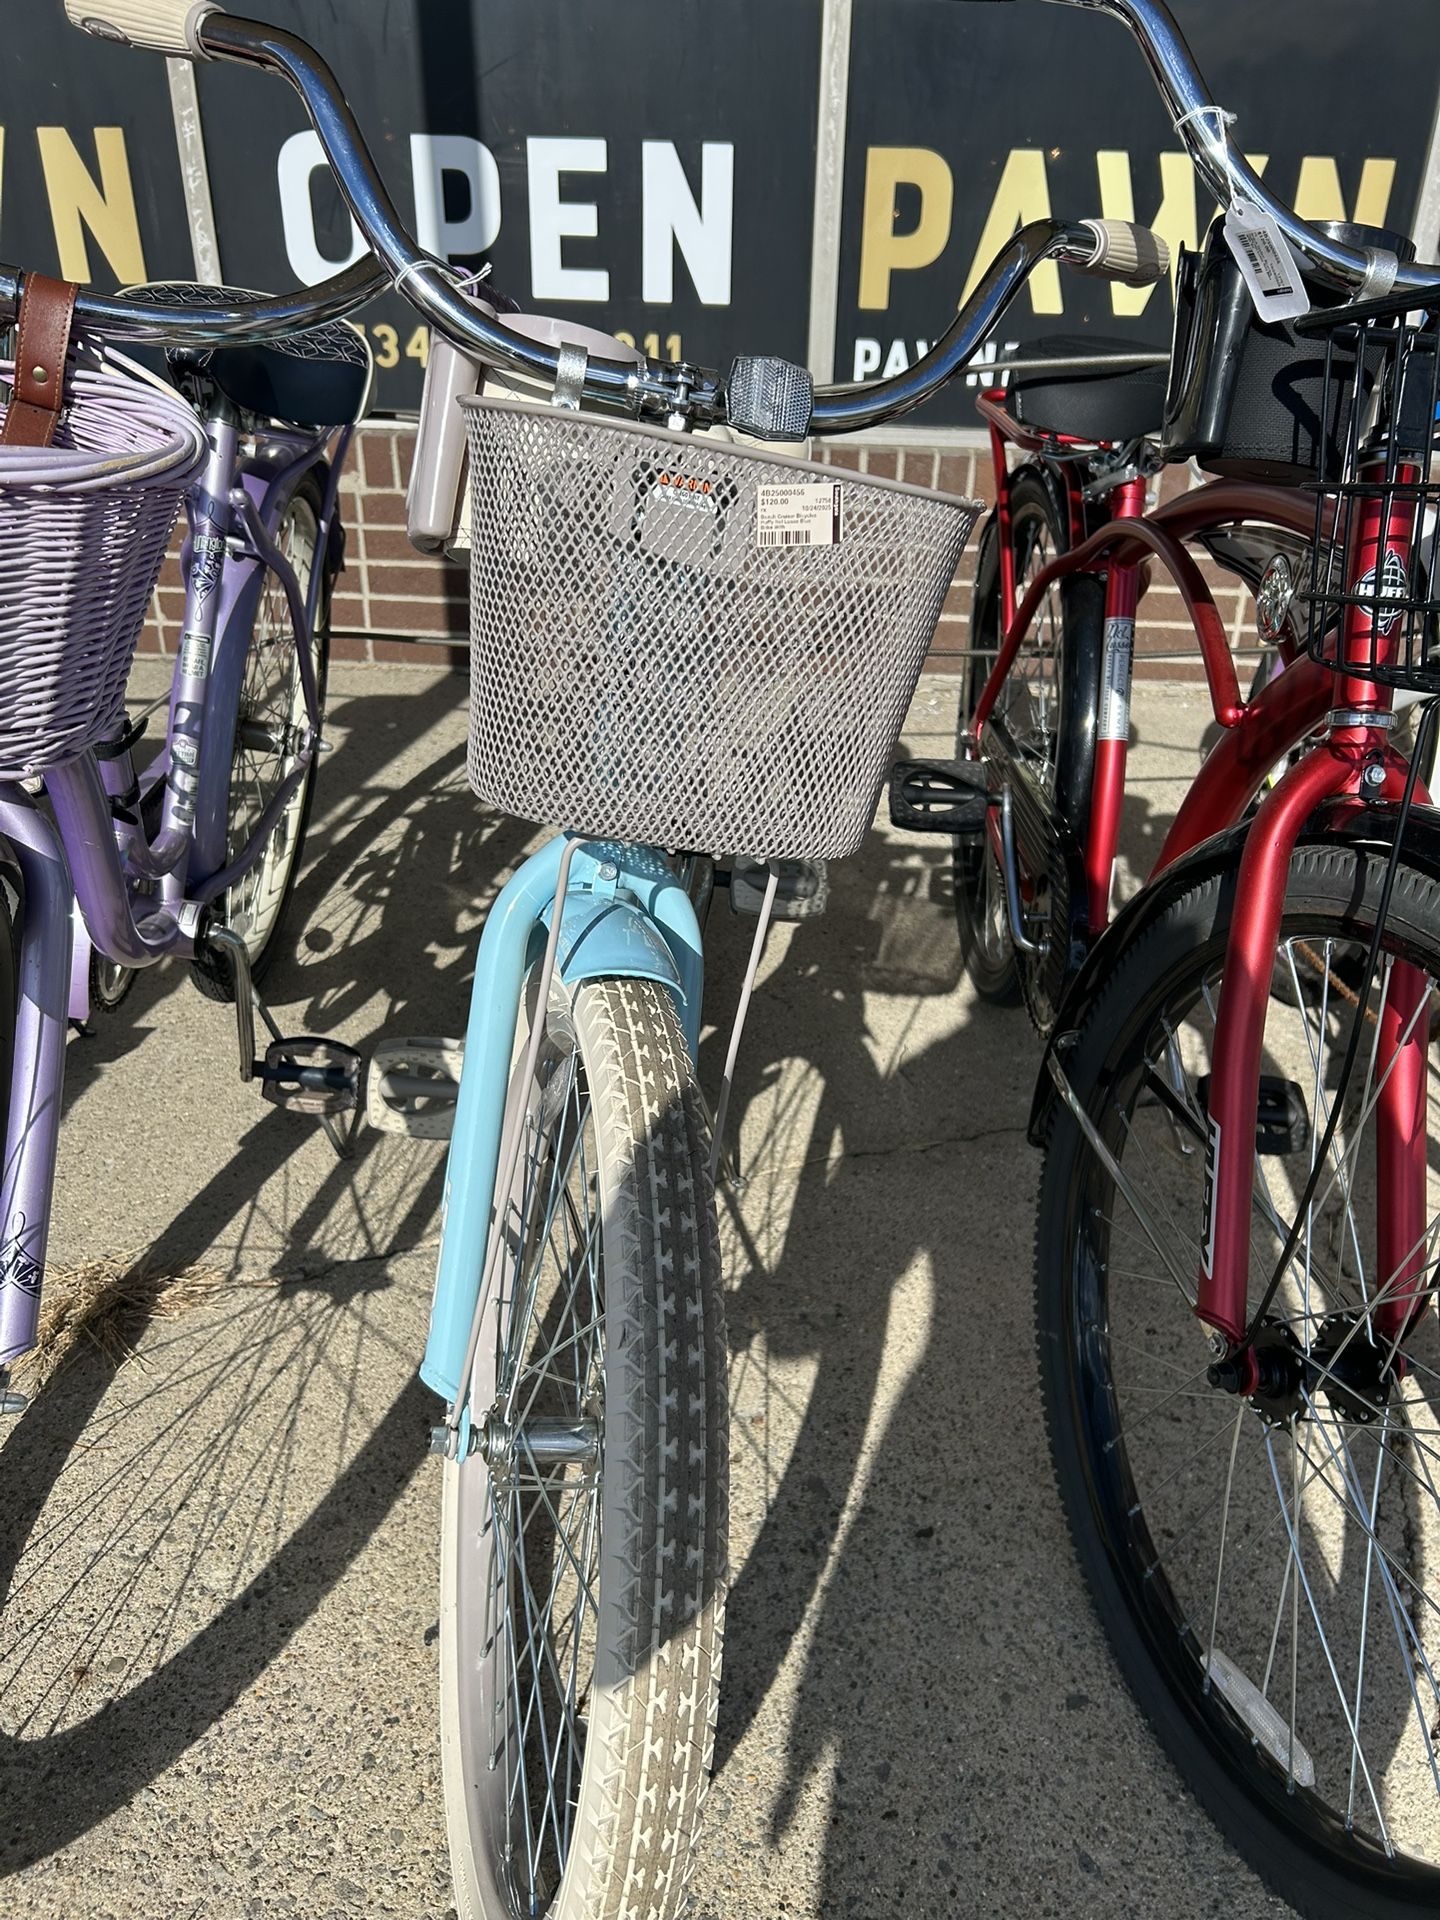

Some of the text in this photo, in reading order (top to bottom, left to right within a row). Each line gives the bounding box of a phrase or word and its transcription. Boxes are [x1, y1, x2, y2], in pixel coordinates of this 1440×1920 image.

[0, 127, 147, 284] N
[277, 129, 734, 305] OPEN
[353, 324, 429, 368] 34
